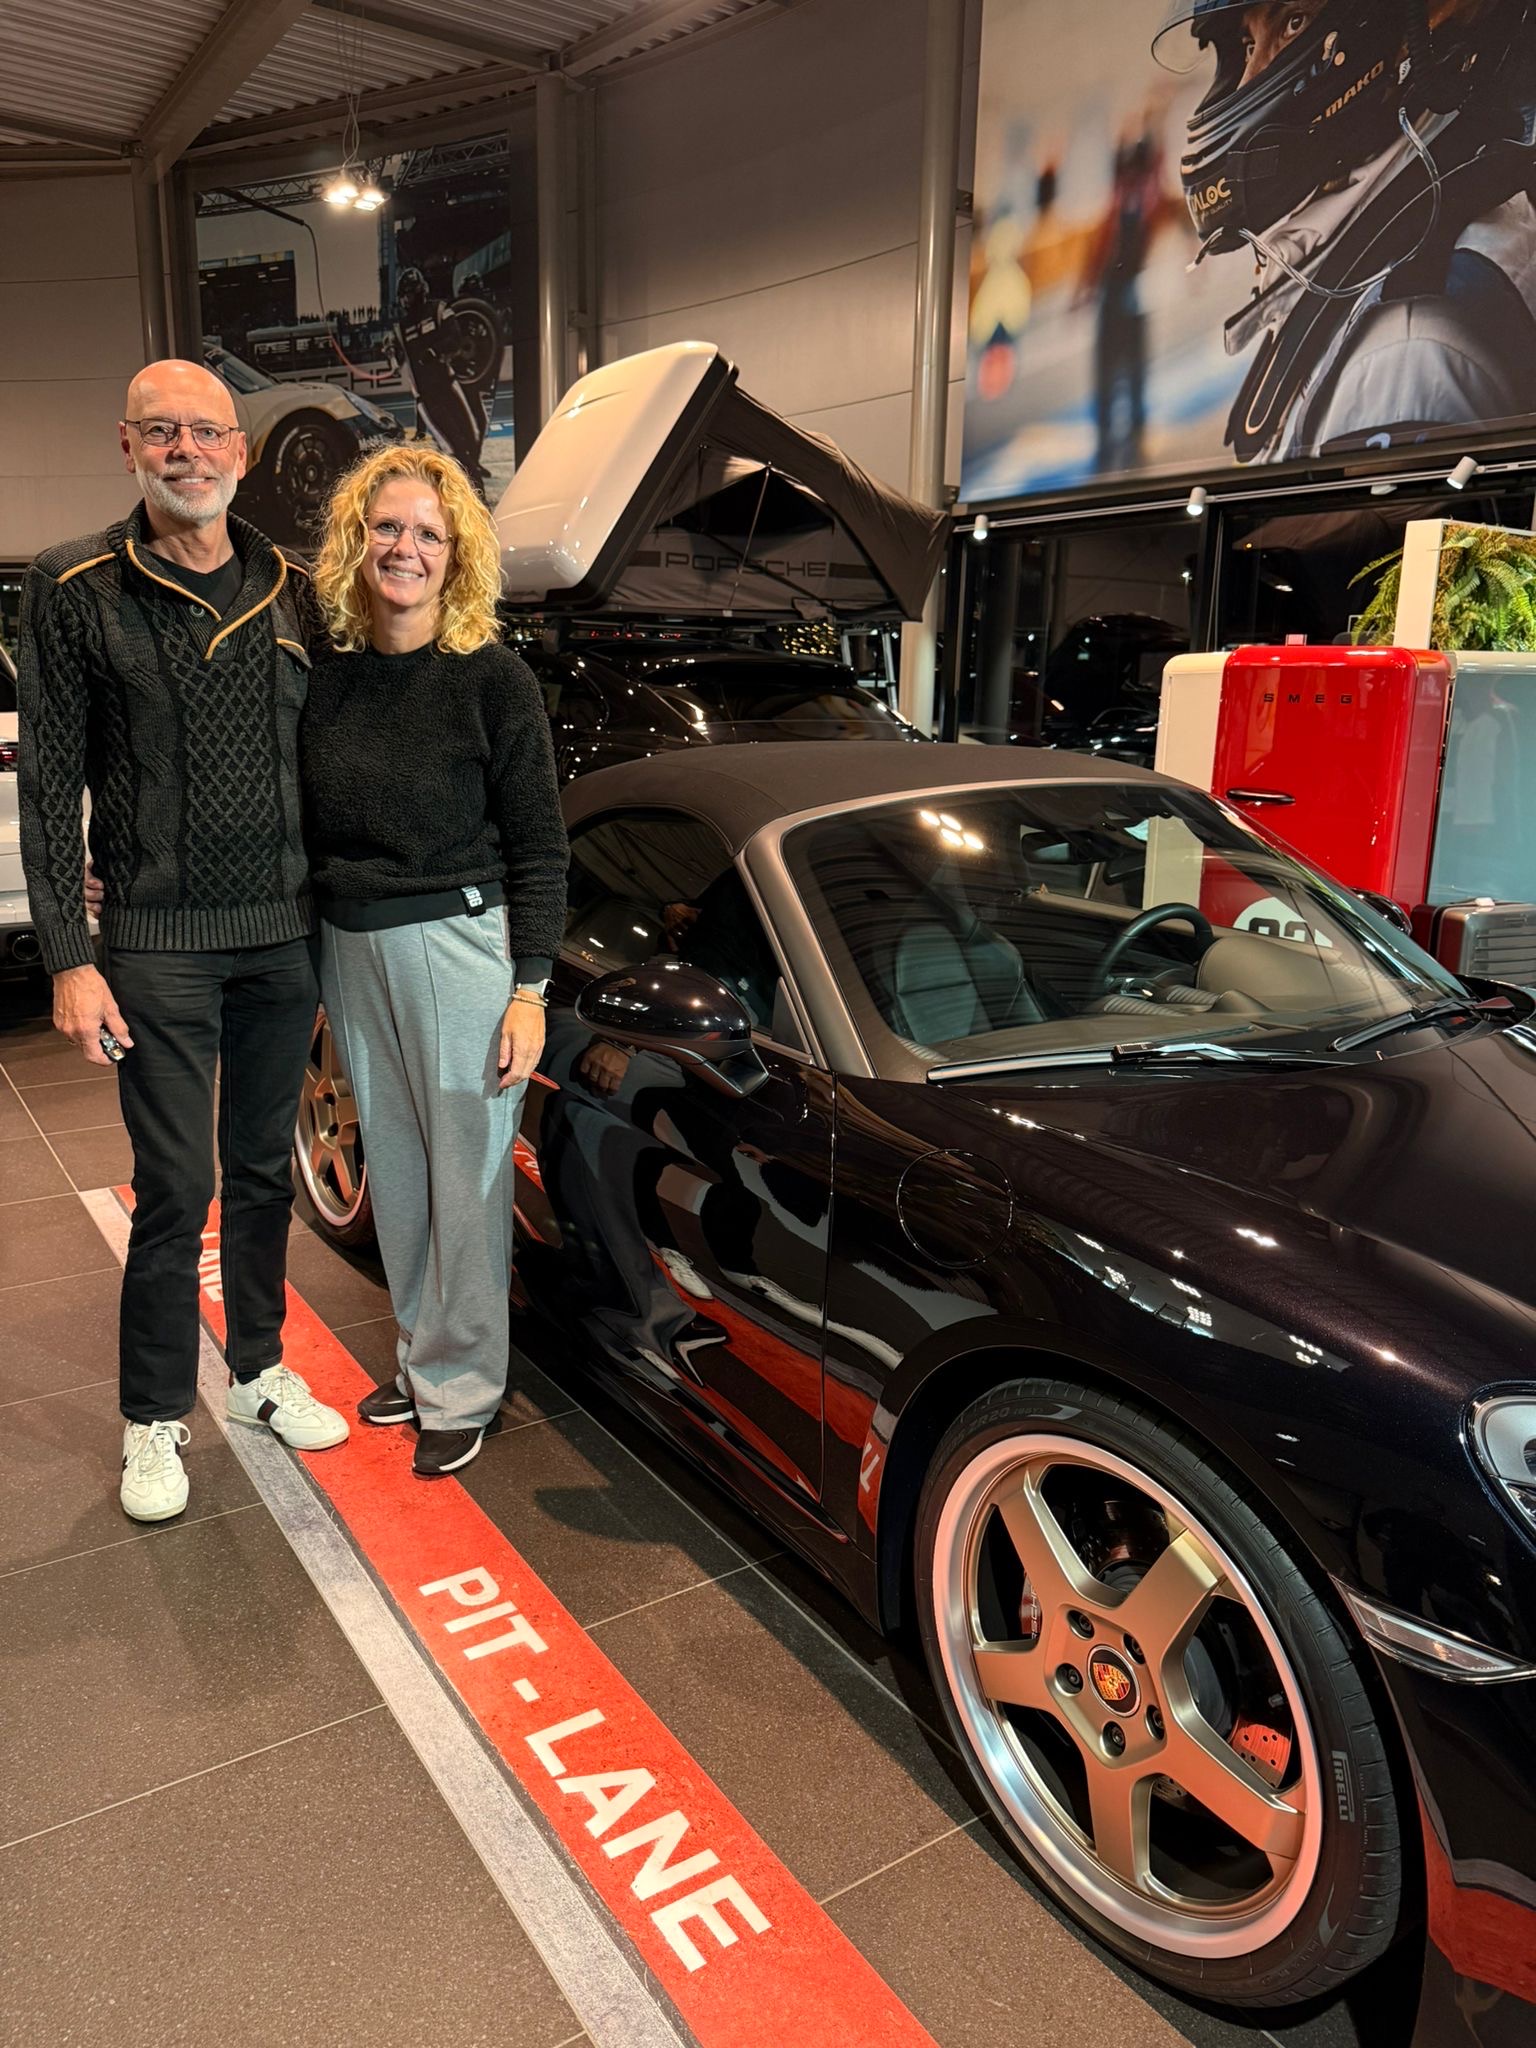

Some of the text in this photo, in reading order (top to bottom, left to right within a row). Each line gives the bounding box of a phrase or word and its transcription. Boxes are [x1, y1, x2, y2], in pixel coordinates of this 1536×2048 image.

[1263, 692, 1353, 705] SMEG
[418, 1566, 549, 1661] PIT
[524, 1707, 772, 1973] LANE
[1331, 1750, 1355, 1823] PIRELLI
